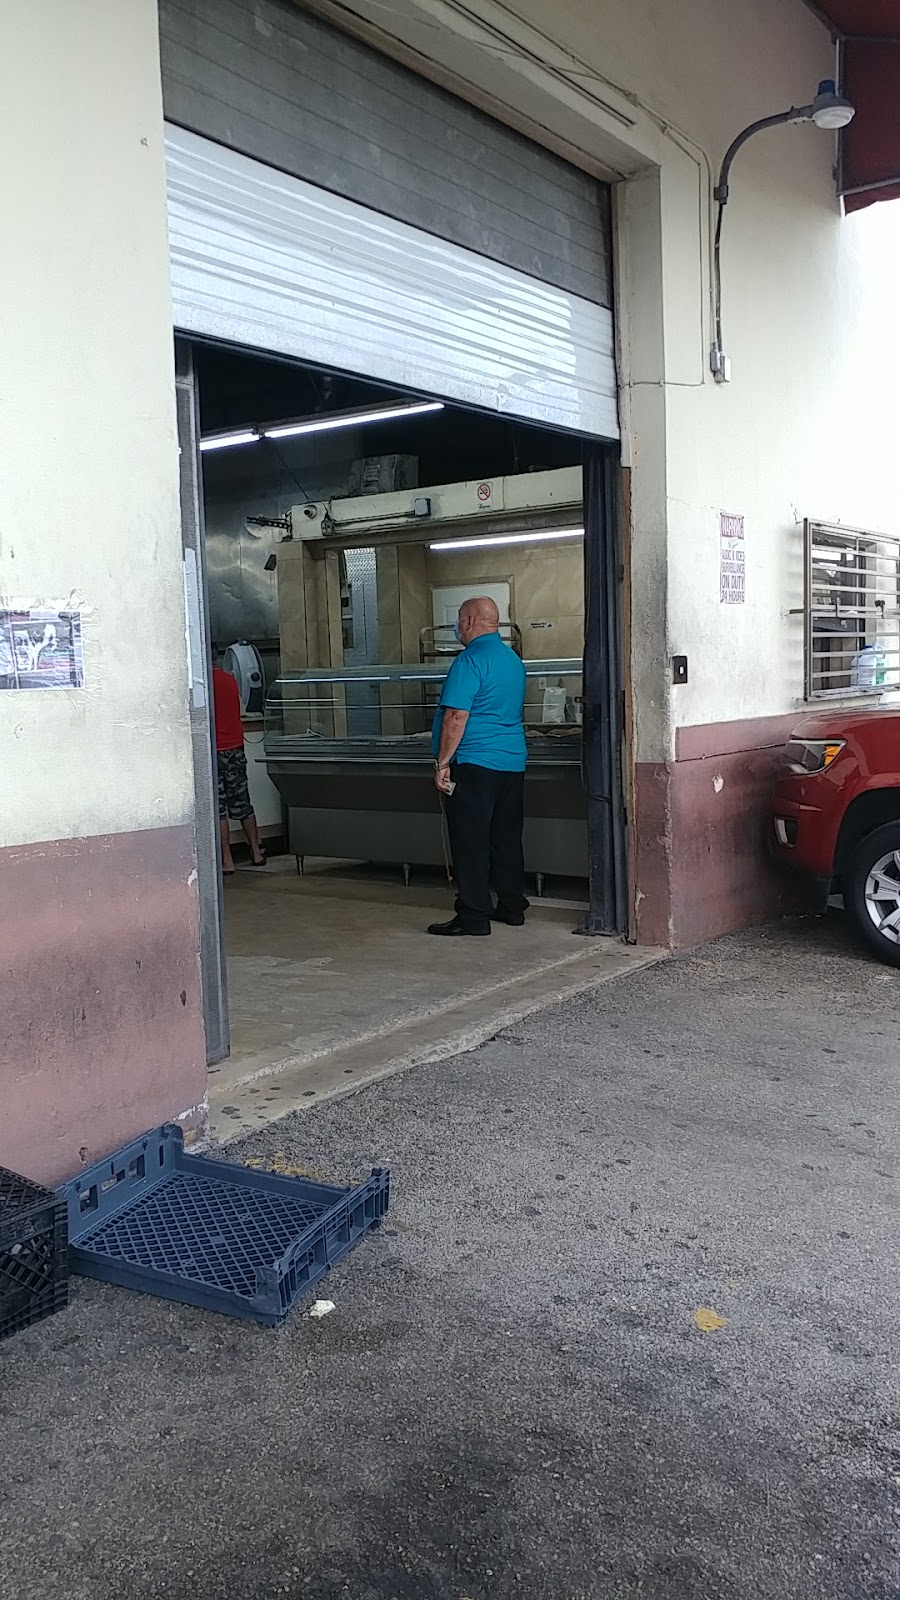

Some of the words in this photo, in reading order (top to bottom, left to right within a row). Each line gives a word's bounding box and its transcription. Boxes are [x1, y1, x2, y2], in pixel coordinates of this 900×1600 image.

[721, 575, 730, 589] ON
[731, 576, 745, 590] DUTY
[721, 590, 728, 601] 24
[729, 591, 745, 602] HOURS
